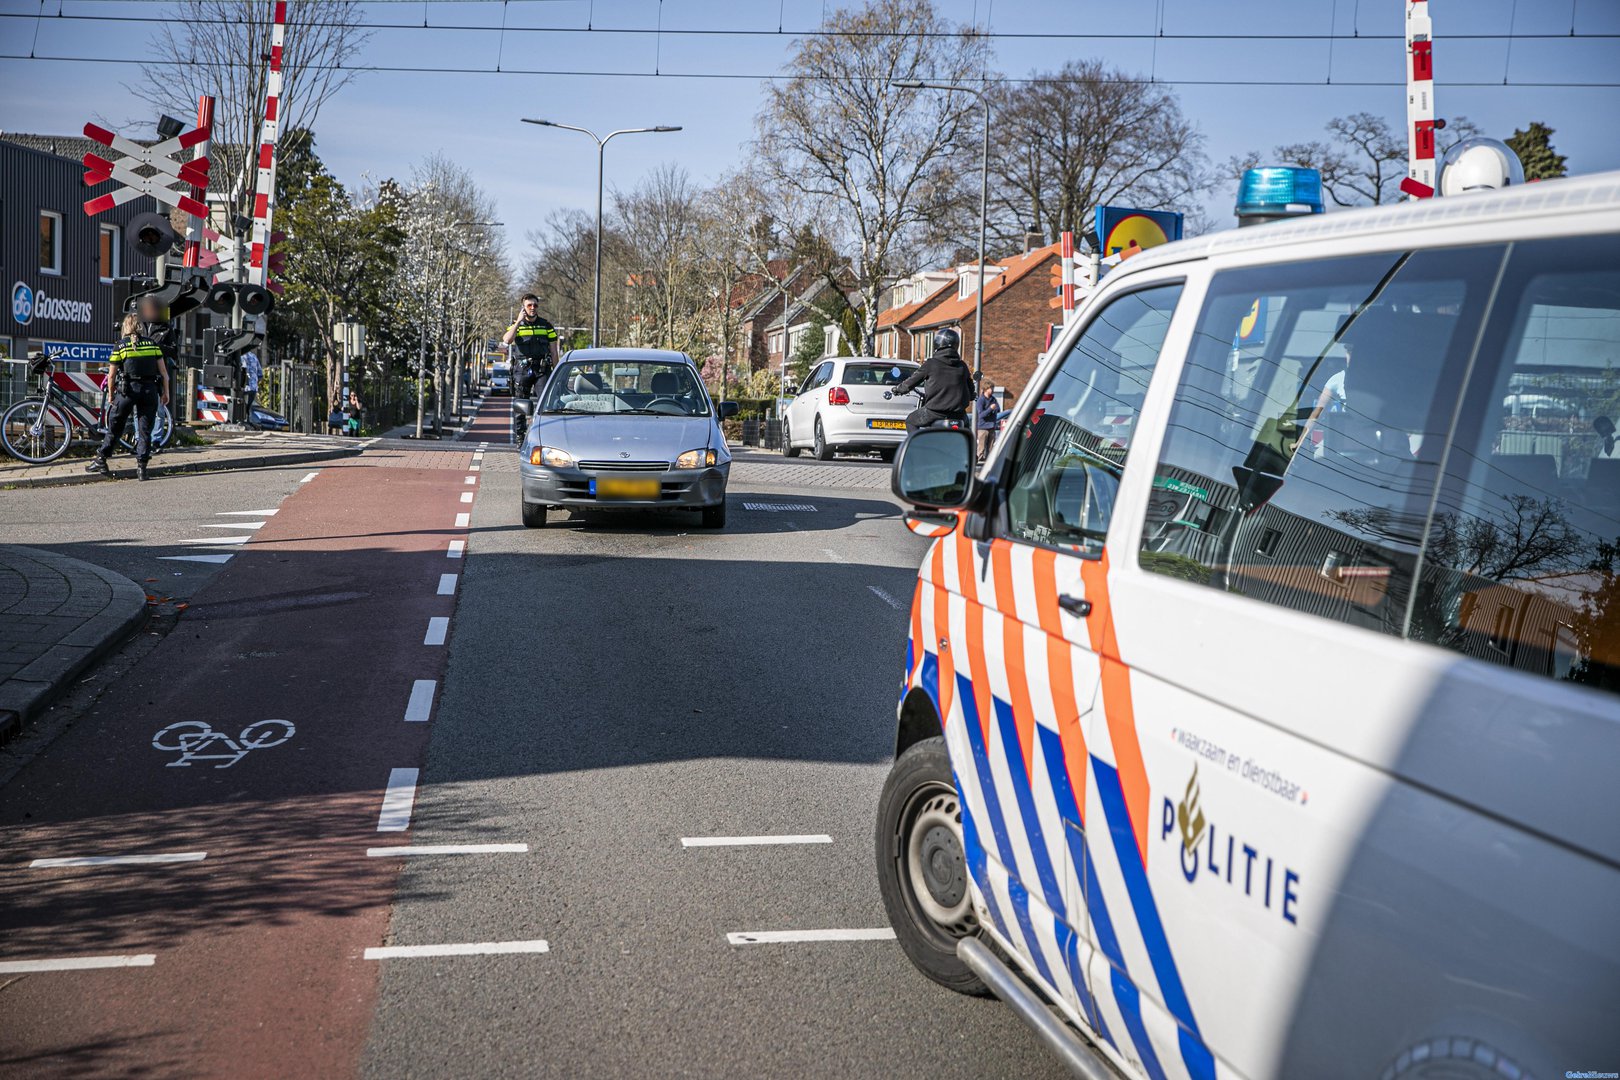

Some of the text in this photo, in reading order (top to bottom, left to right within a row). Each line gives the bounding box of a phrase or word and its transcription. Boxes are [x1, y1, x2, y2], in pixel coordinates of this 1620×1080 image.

[35, 290, 92, 323] Goossens
[48, 345, 99, 358] WACHT
[1177, 731, 1300, 802] waakzaam en dienstbaar
[1162, 795, 1299, 926] POLITIE
